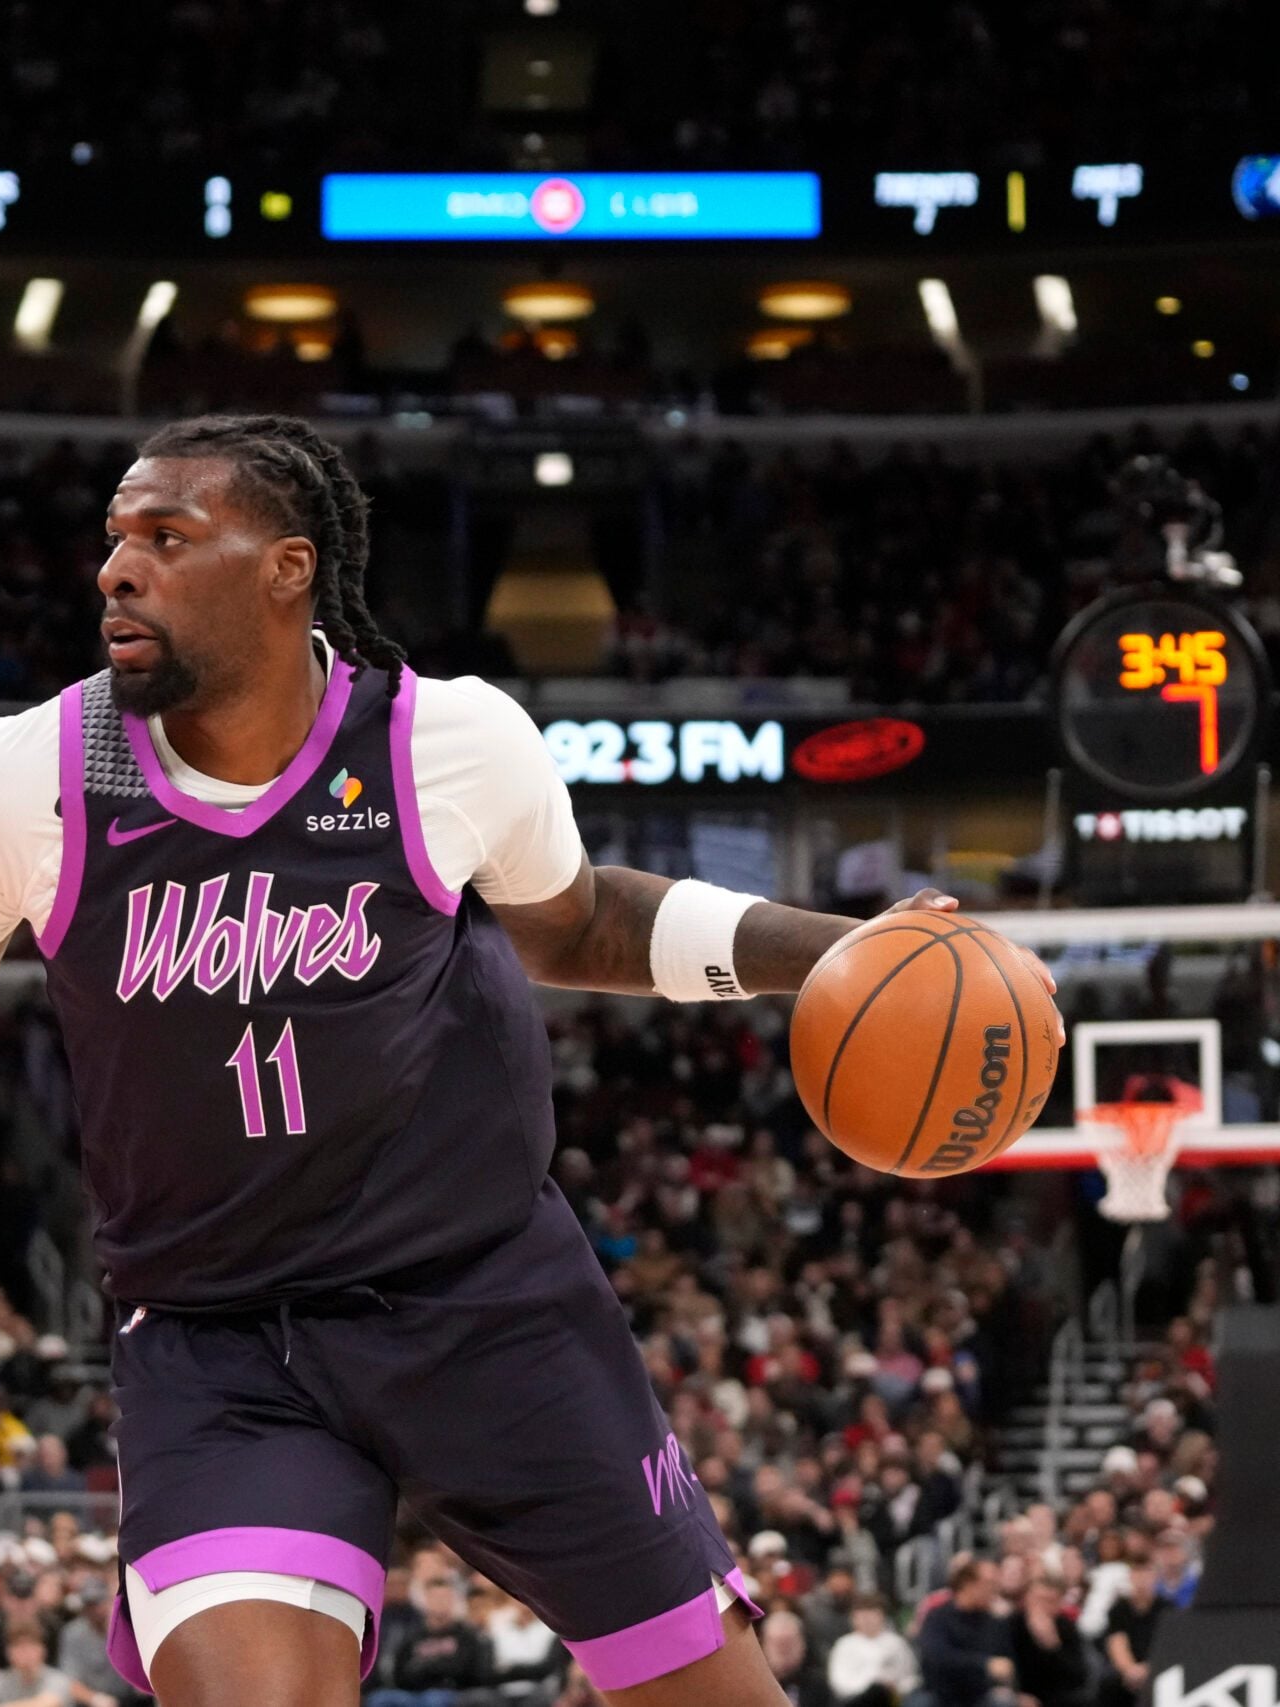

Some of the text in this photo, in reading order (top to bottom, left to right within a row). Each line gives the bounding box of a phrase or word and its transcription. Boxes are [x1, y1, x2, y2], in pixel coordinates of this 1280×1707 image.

[1119, 631, 1227, 689] 3:45
[541, 720, 676, 785] 92.3
[679, 720, 784, 783] FM
[1161, 683, 1219, 775] 7
[306, 807, 391, 832] sezzle
[116, 871, 382, 1005] Wolves
[225, 1016, 306, 1138] 11
[918, 1022, 1012, 1172] Wilson
